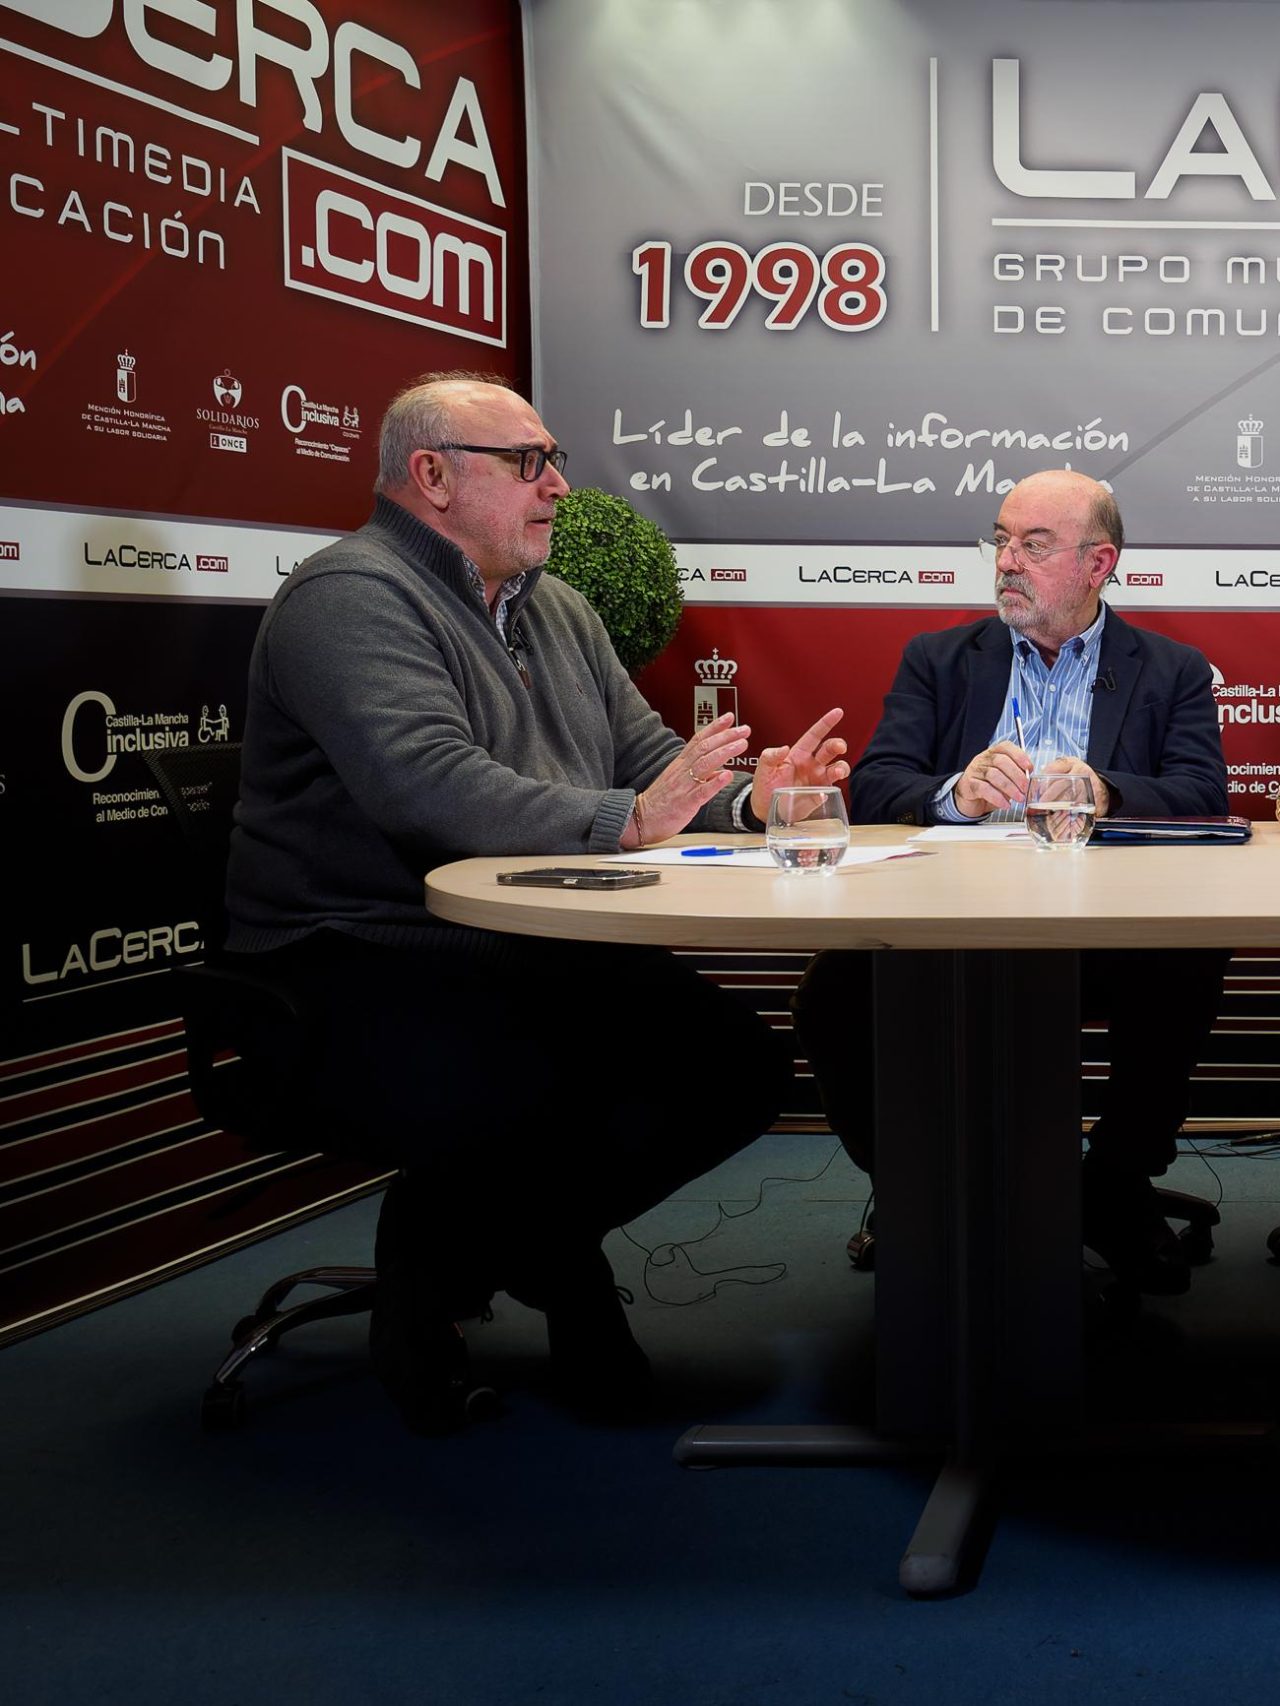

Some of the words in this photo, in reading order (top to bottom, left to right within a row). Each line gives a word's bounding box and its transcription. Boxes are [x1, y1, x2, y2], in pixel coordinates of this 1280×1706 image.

[744, 182, 884, 217] DESDE
[993, 253, 1190, 284] GRUPO
[632, 240, 888, 333] 1998
[993, 305, 1066, 335] DE
[196, 407, 260, 429] SOLIDARIOS
[301, 407, 340, 427] inclusiva
[612, 408, 743, 447] Líder
[762, 409, 812, 448] de
[832, 410, 866, 448] la
[887, 412, 1129, 452] información
[221, 438, 245, 450] ONCE
[629, 471, 671, 492] en
[691, 456, 937, 494] Castilla-La
[1195, 474, 1241, 483] MENCIÓN
[1186, 485, 1200, 493] DE
[1203, 485, 1267, 493] CASTILLA-LA
[154, 712, 189, 726] Mancha
[106, 726, 190, 753] inclusiva
[1249, 780, 1265, 793] de
[95, 809, 105, 823] al
[106, 806, 136, 822] Medio
[138, 805, 149, 818] de
